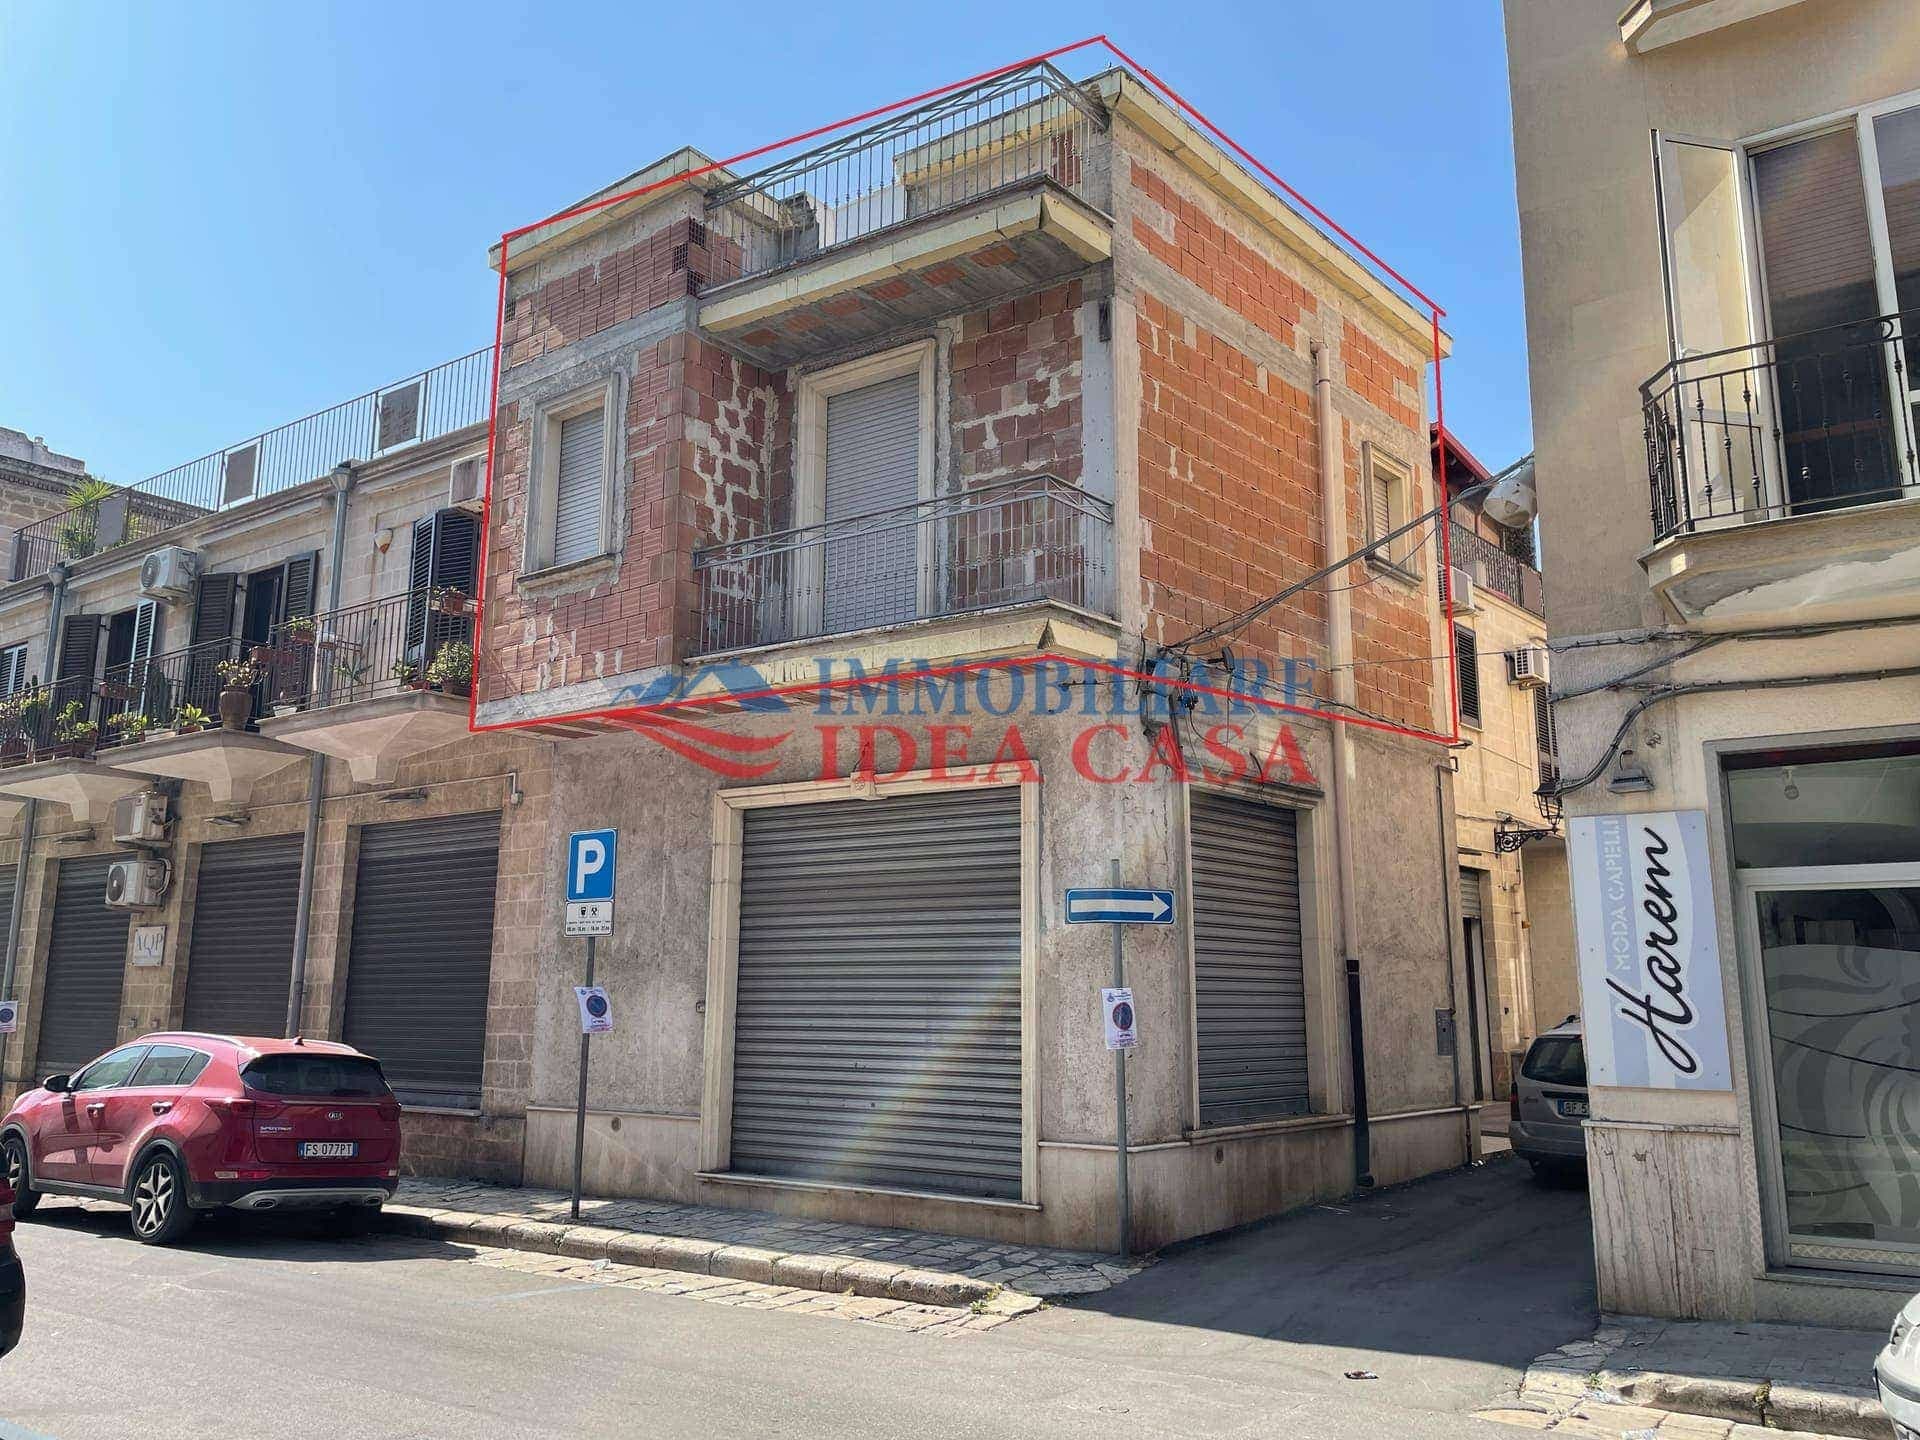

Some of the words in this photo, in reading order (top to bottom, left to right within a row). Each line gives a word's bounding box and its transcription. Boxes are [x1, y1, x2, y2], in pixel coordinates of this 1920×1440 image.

[576, 839, 606, 894] P
[1602, 819, 1625, 901] CAPELLI
[1605, 827, 1697, 1074] Harem
[1611, 905, 1631, 971] MODA
[305, 1143, 318, 1155] FS
[321, 1143, 352, 1155] 077PT
